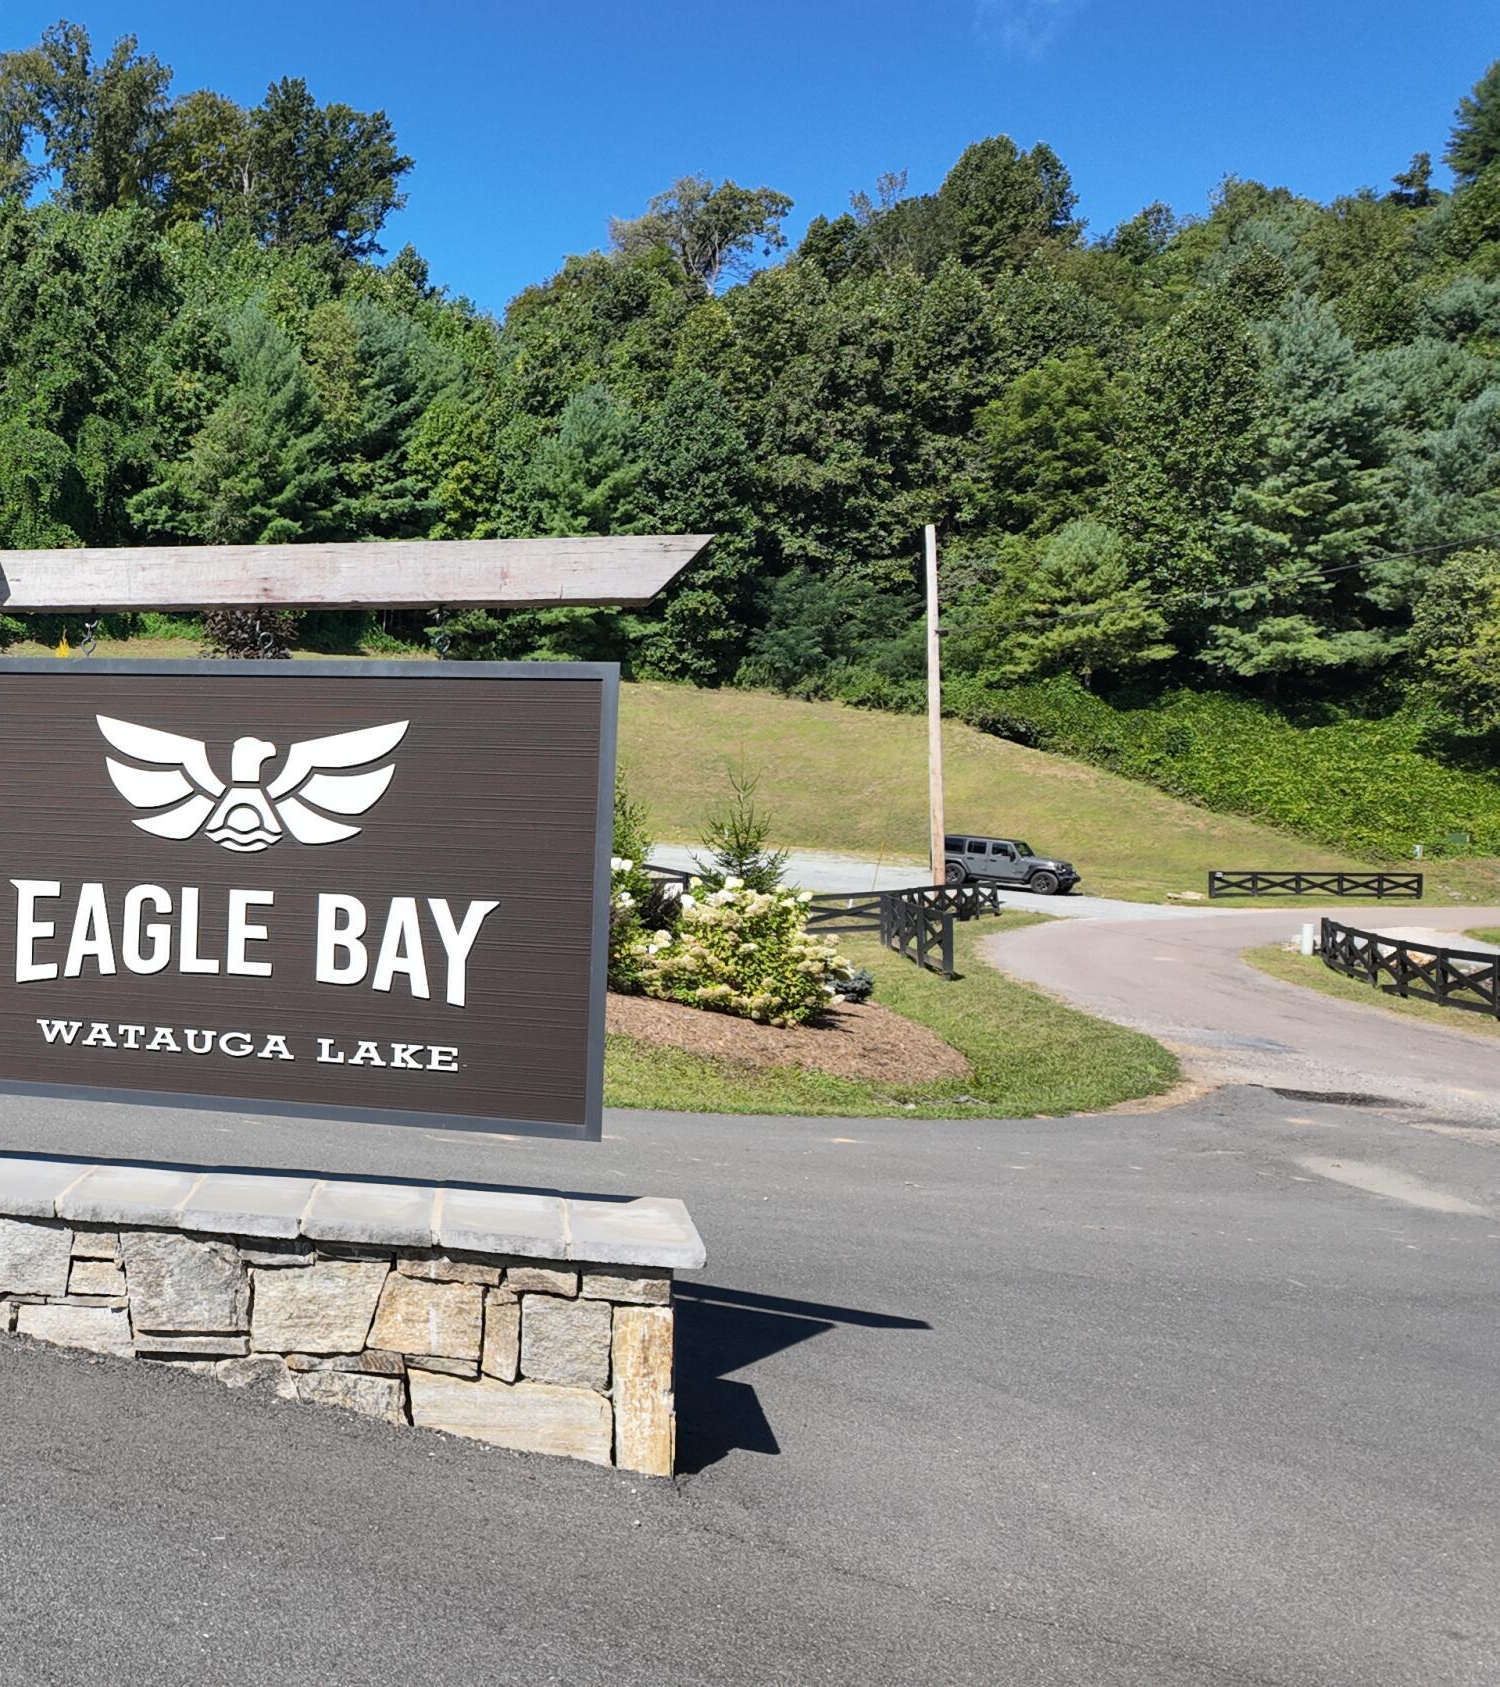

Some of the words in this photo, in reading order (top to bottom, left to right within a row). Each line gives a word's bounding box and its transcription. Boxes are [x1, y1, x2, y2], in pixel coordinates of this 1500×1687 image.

[10, 880, 274, 983] EAGLE
[316, 894, 500, 1007] BAY
[37, 1019, 295, 1060] WATAUGA
[317, 1039, 459, 1072] LAKE
